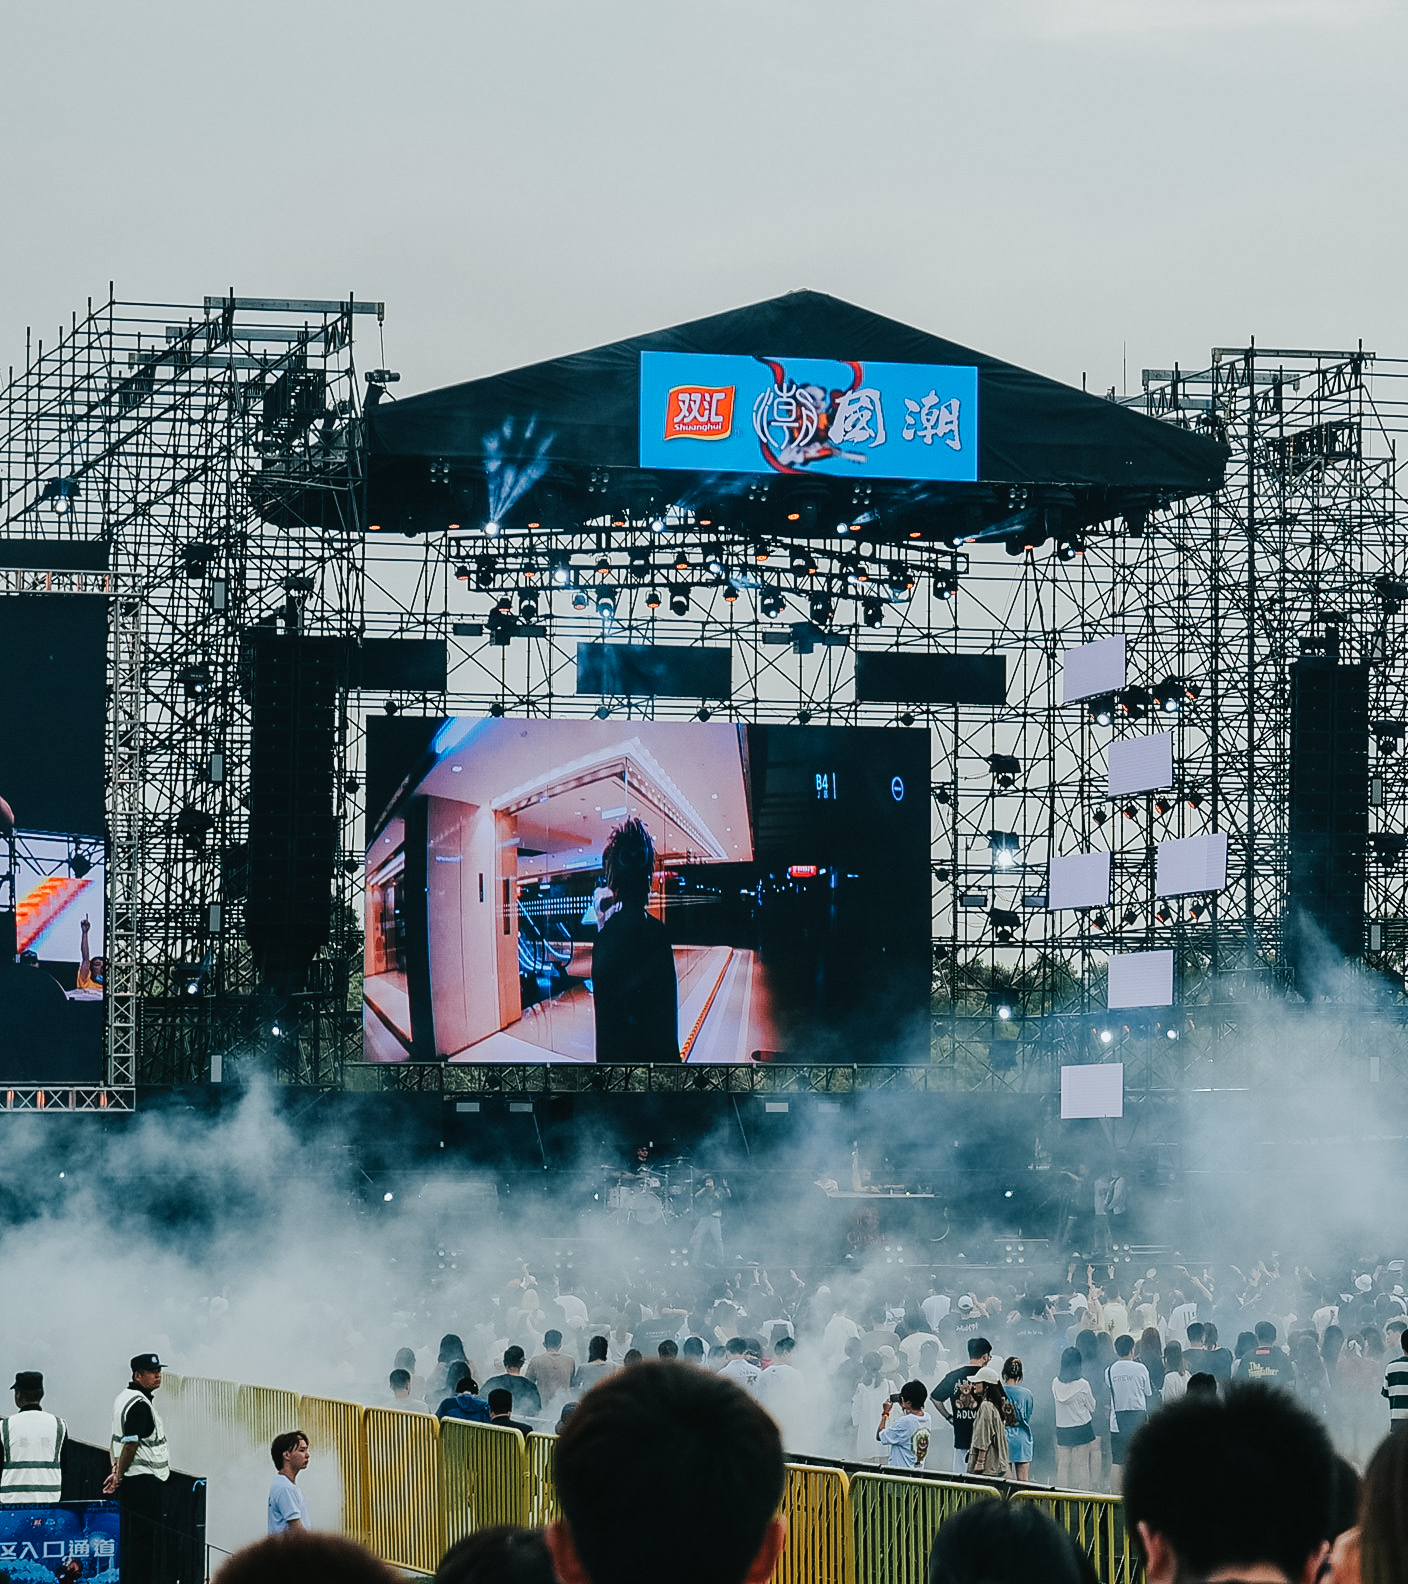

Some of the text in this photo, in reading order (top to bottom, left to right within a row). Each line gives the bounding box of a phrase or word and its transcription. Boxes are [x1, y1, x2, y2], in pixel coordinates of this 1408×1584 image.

[674, 392, 726, 423] 双汇
[673, 422, 722, 432] Shuanghui
[0, 1539, 115, 1560] 区入口通道
